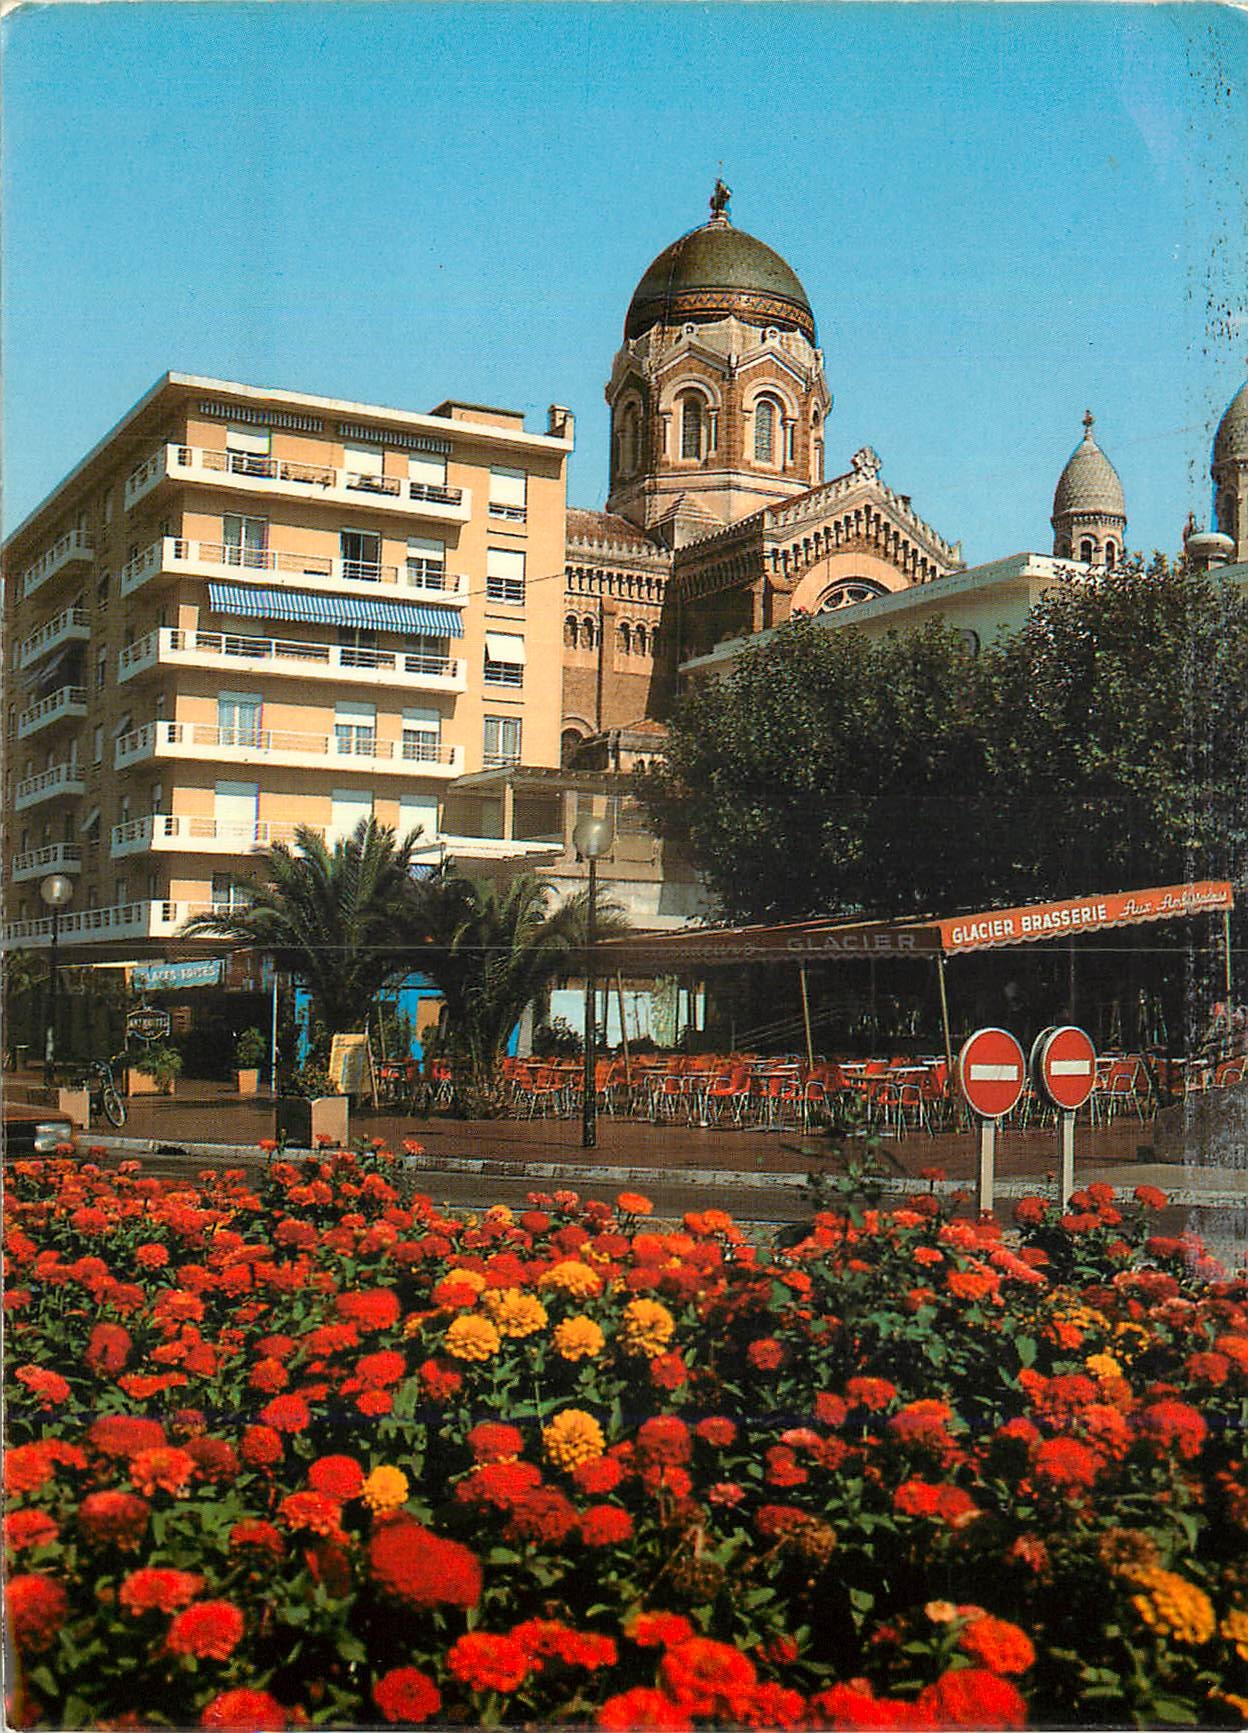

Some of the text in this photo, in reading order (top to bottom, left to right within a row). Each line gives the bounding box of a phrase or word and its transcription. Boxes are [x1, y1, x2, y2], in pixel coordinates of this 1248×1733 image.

[952, 918, 1014, 944] GLACIER
[1021, 903, 1107, 932] BRASSERIE
[1119, 898, 1153, 916] Aux
[787, 933, 915, 951] GLACIER
